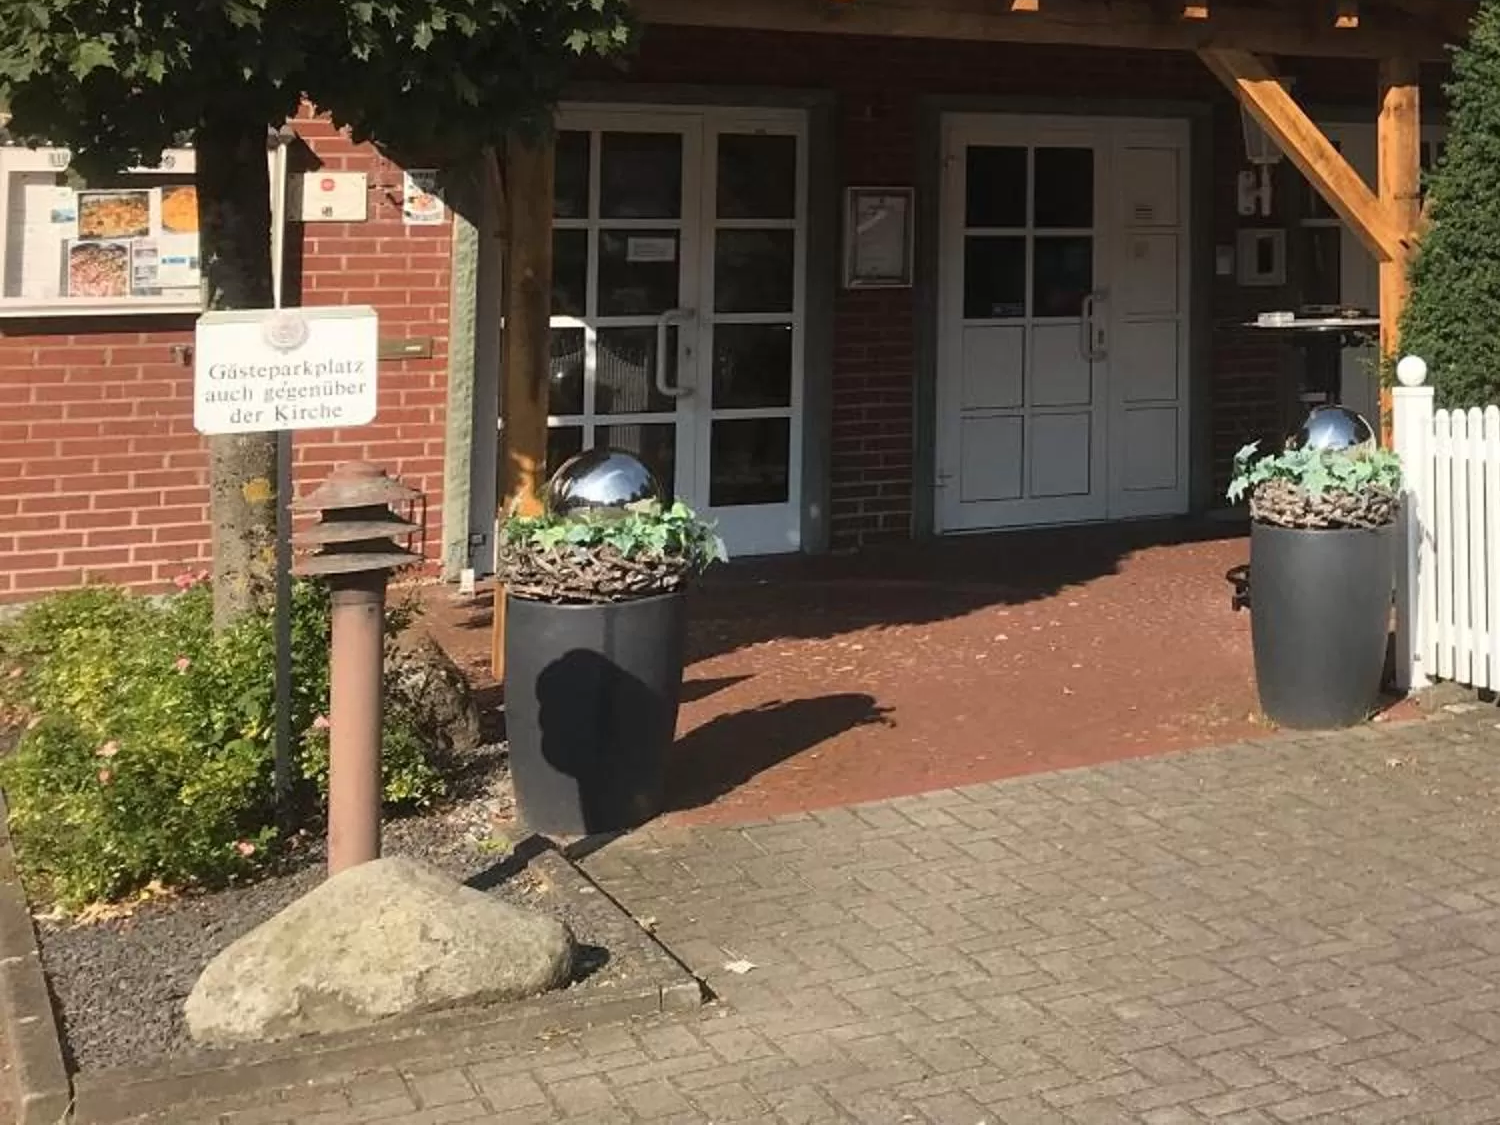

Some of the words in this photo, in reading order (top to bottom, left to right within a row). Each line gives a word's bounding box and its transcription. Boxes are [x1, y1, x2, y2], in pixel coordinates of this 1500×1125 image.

[207, 358, 365, 380] Gästeparkplatz
[204, 385, 253, 404] auch
[263, 381, 367, 404] gegenüber
[229, 408, 264, 424] der
[274, 403, 343, 423] Kirche
